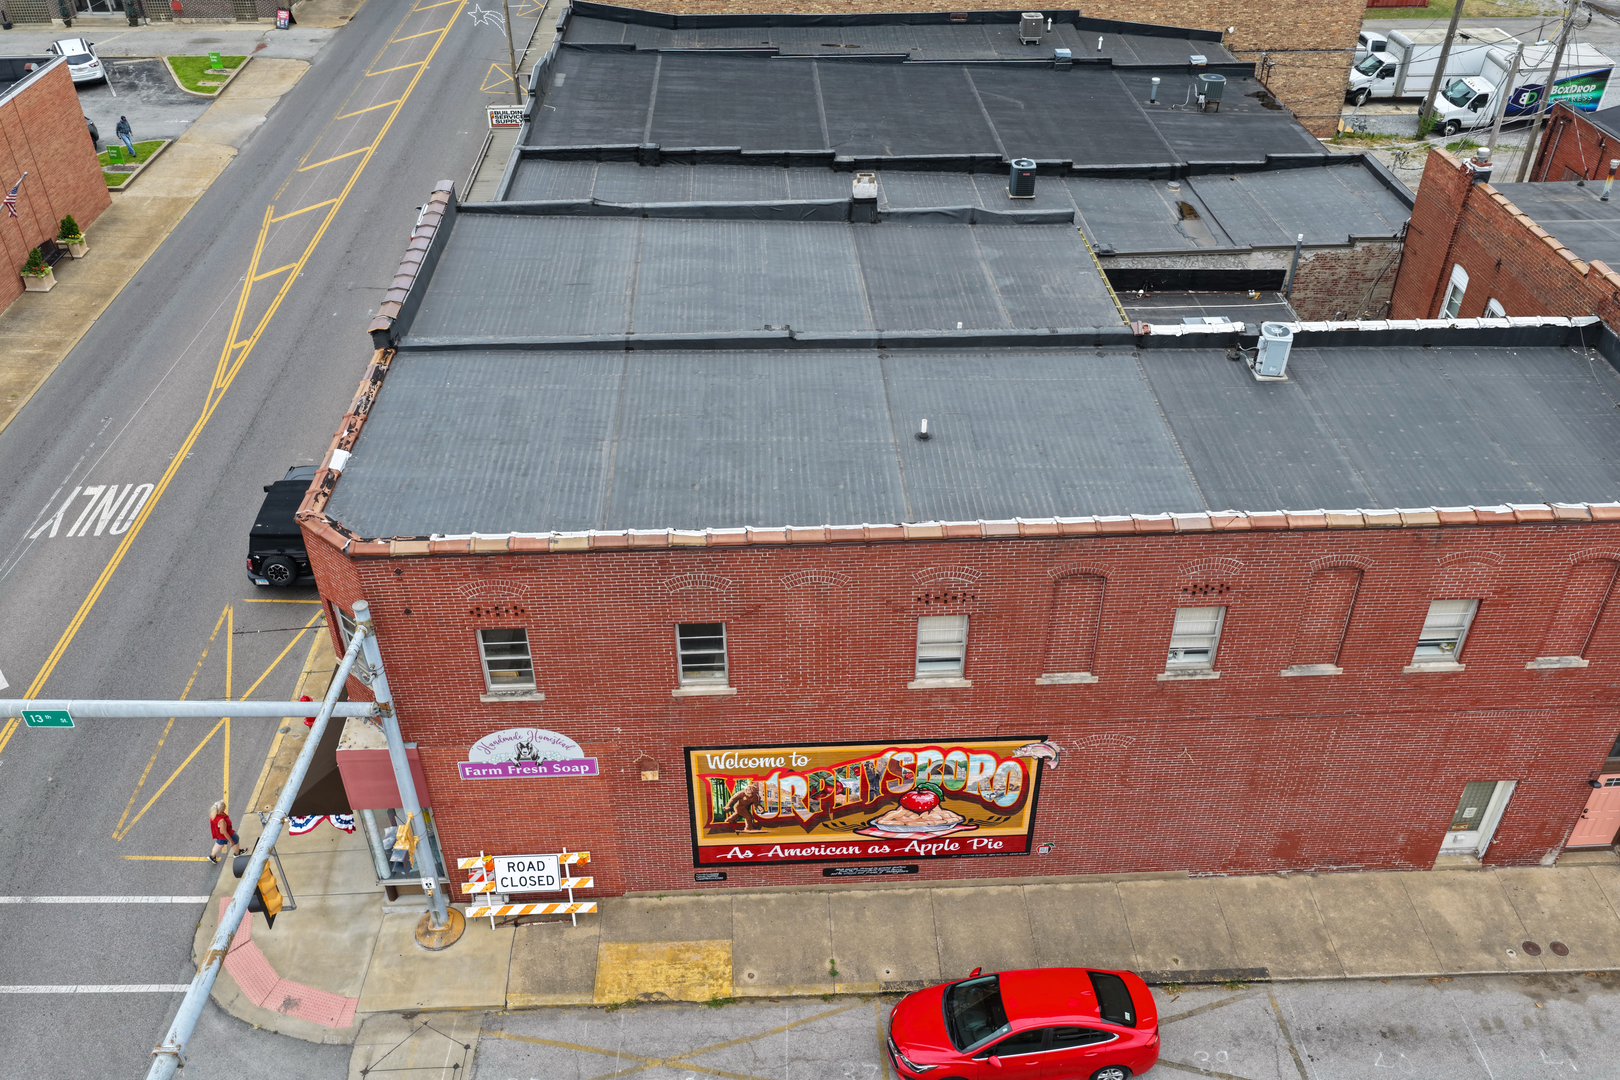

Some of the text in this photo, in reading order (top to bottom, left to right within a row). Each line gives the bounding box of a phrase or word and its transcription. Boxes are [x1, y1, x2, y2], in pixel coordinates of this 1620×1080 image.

[29, 483, 155, 539] ONLY
[477, 730, 576, 755] Handmade Homestead
[464, 763, 590, 776] Farm Fresh Soap
[705, 751, 812, 770] Welcome to
[705, 748, 1026, 825] MURPHYSBORO
[716, 846, 754, 859] As
[757, 844, 862, 858] American
[867, 844, 891, 854] as
[894, 838, 960, 856] Apple
[966, 837, 1004, 850] Pie
[507, 860, 546, 873] ROAD
[500, 875, 555, 888] CLOSED
